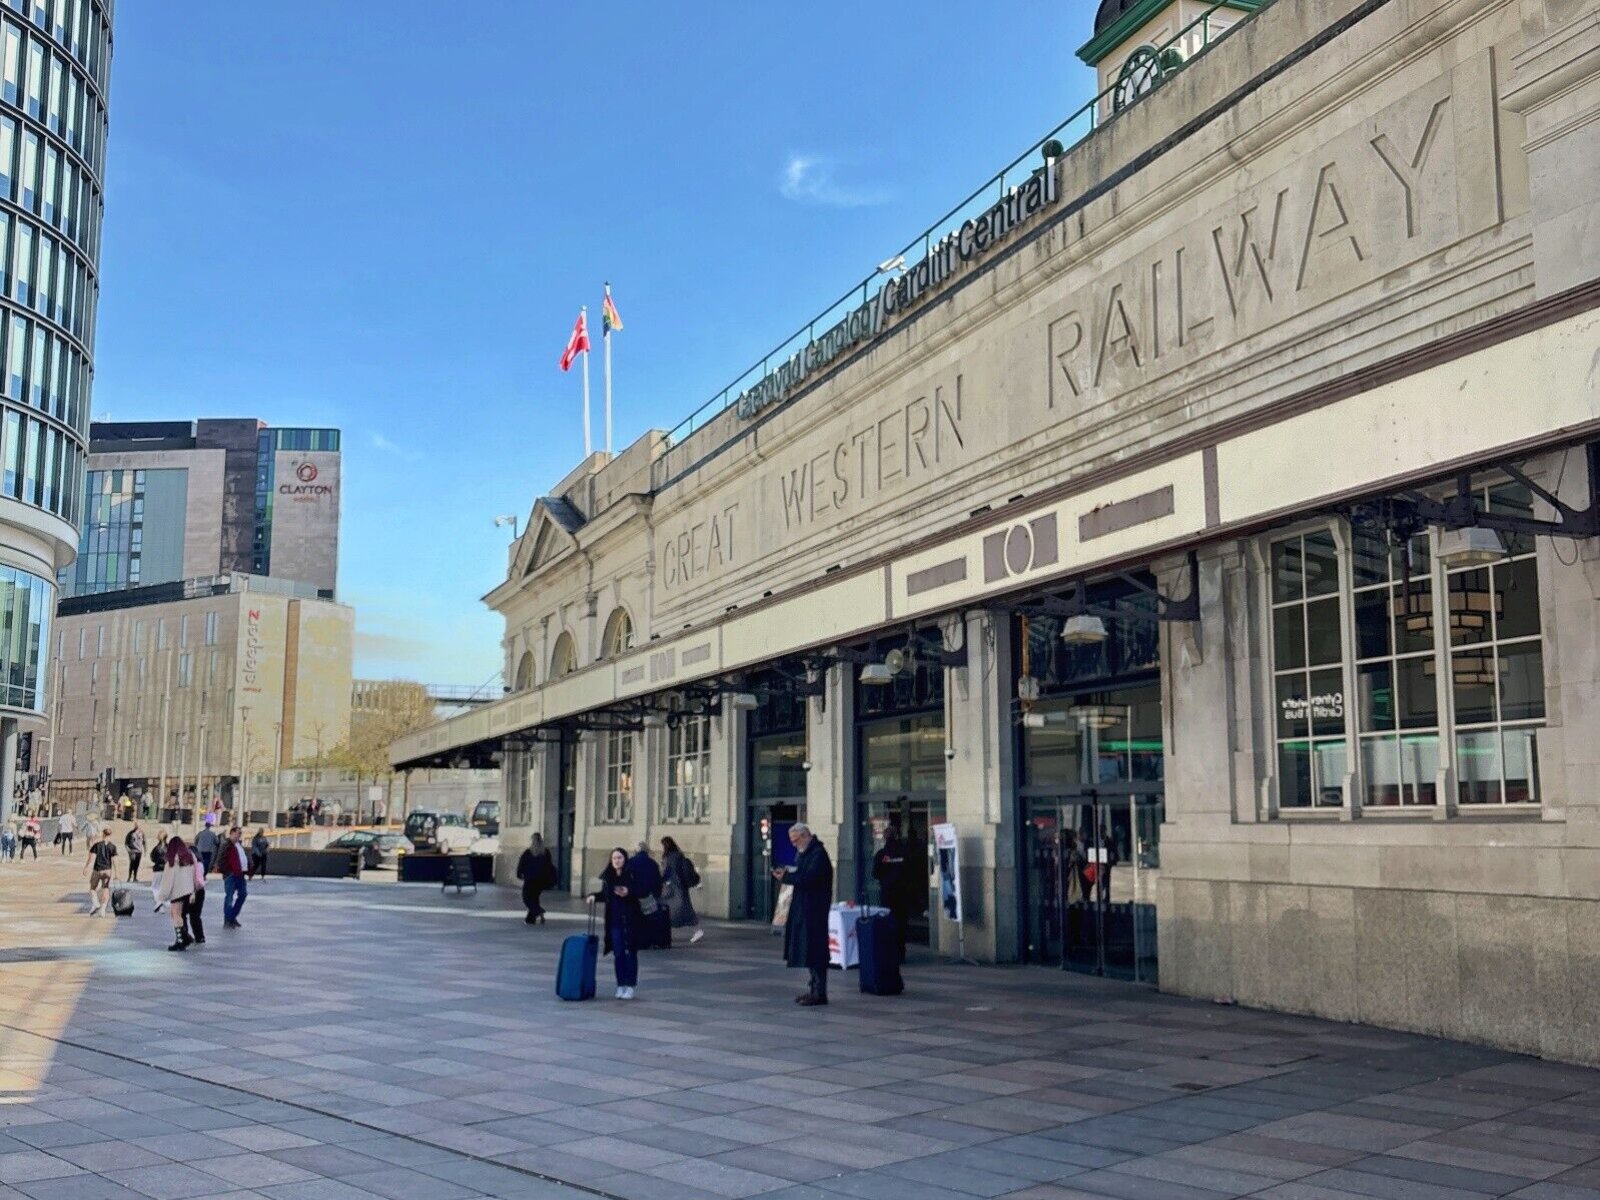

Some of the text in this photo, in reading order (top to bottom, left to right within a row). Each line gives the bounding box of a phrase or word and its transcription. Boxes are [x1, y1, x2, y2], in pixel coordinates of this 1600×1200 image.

[958, 156, 1059, 262] Central
[663, 95, 1451, 591] GREAT WESTERN RAILWAY
[279, 484, 333, 495] CLAYTON
